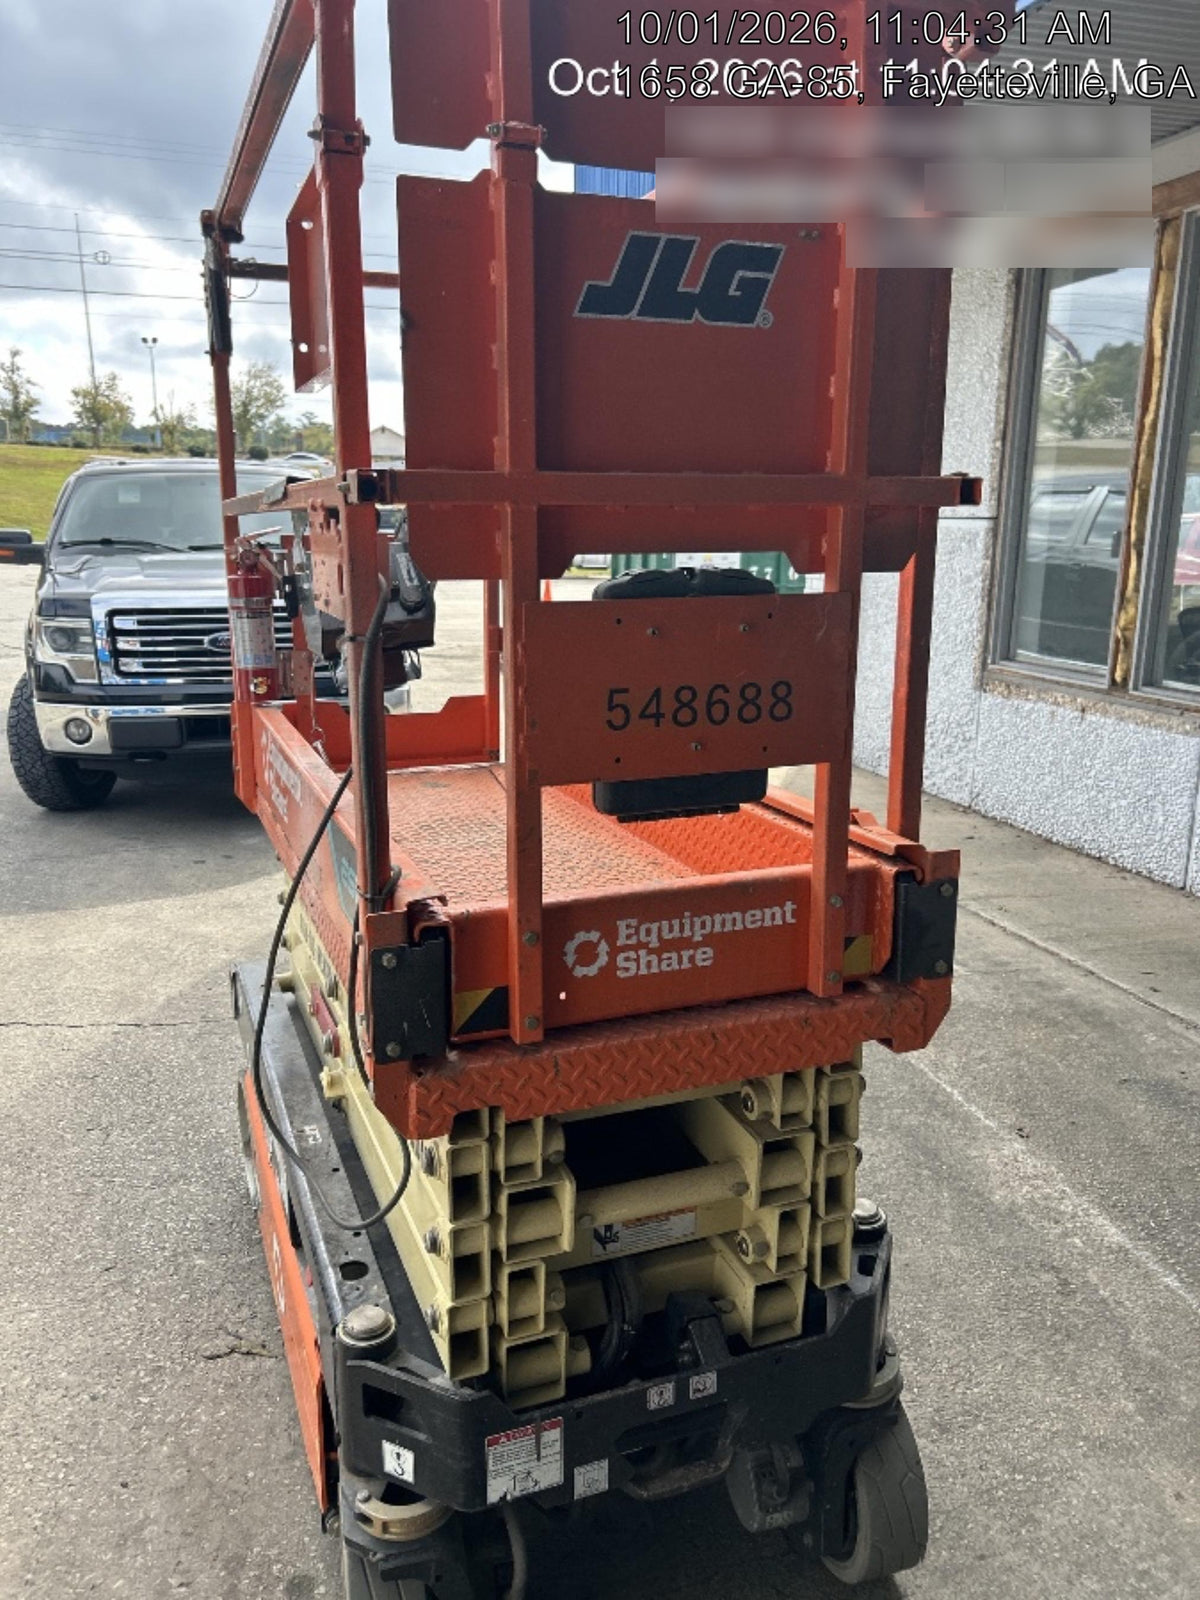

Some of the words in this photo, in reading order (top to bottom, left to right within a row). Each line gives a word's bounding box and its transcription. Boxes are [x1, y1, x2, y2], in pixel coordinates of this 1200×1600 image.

[572, 231, 786, 328] JLG
[606, 680, 793, 731] 548688
[616, 901, 797, 948] Equipment
[616, 947, 714, 978] Share
